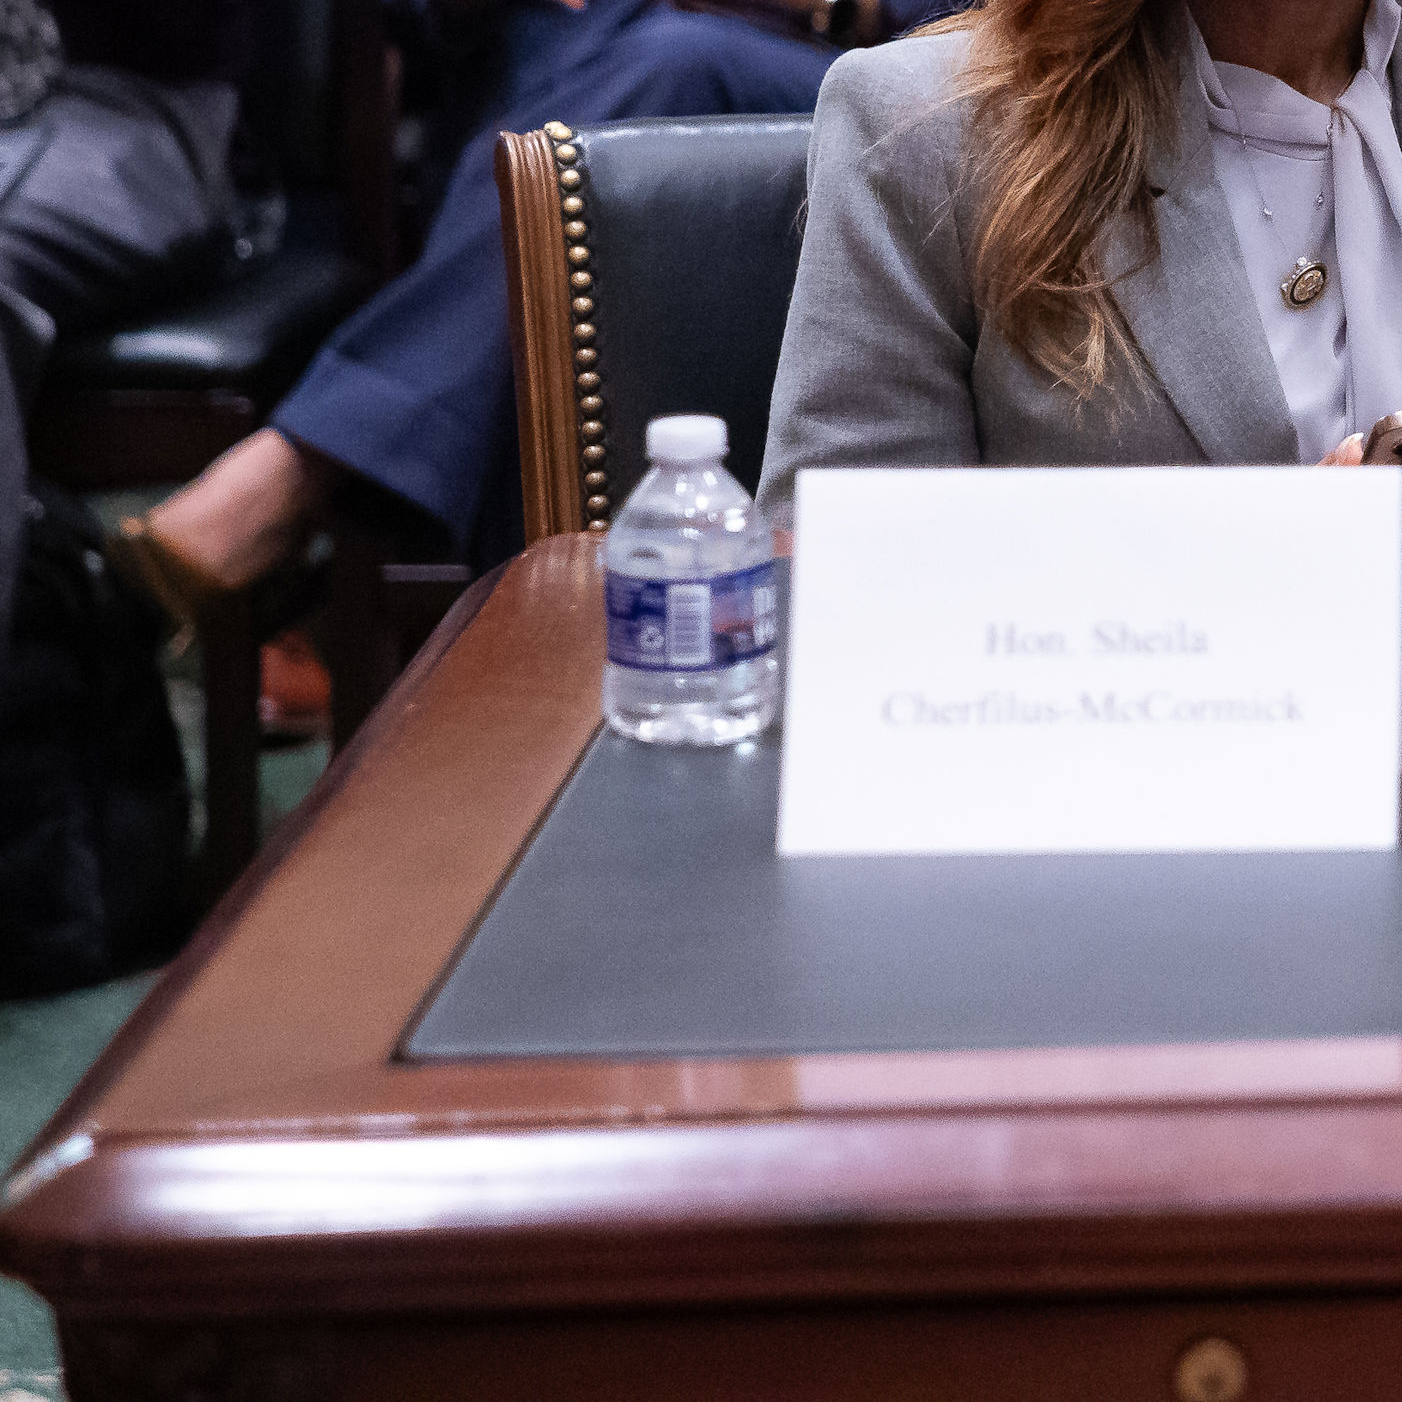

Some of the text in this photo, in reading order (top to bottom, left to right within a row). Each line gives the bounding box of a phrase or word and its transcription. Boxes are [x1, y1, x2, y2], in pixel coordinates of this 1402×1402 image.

[982, 618, 1210, 658] Hon. Sheila
[880, 688, 1304, 727] Cherfilus-McCormick
